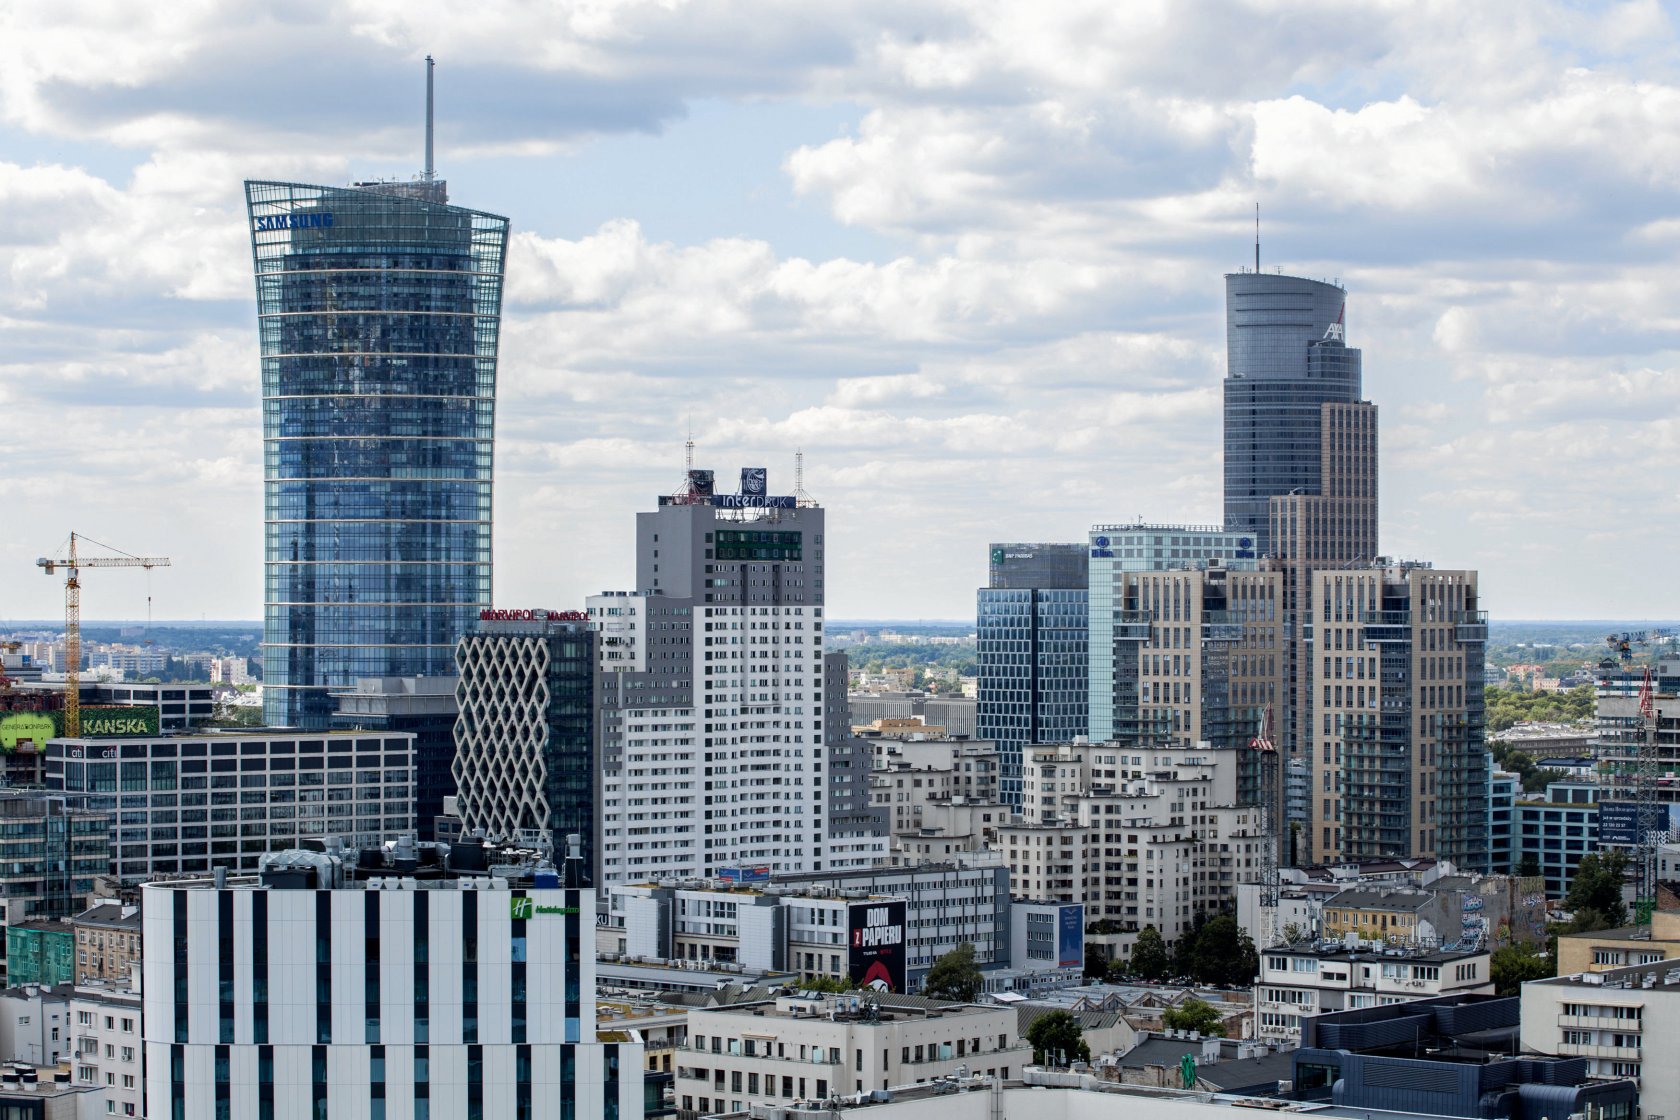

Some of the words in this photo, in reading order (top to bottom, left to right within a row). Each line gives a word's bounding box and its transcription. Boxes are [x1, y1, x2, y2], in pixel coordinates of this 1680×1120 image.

[257, 212, 333, 231] SAMSUNG
[1323, 322, 1343, 340] AXA
[480, 609, 537, 621] MARVIPOL
[547, 611, 591, 621] MARVIPOL
[83, 719, 148, 734] KANSKA
[866, 907, 889, 928] DOM
[862, 925, 902, 947] PAPIERU
